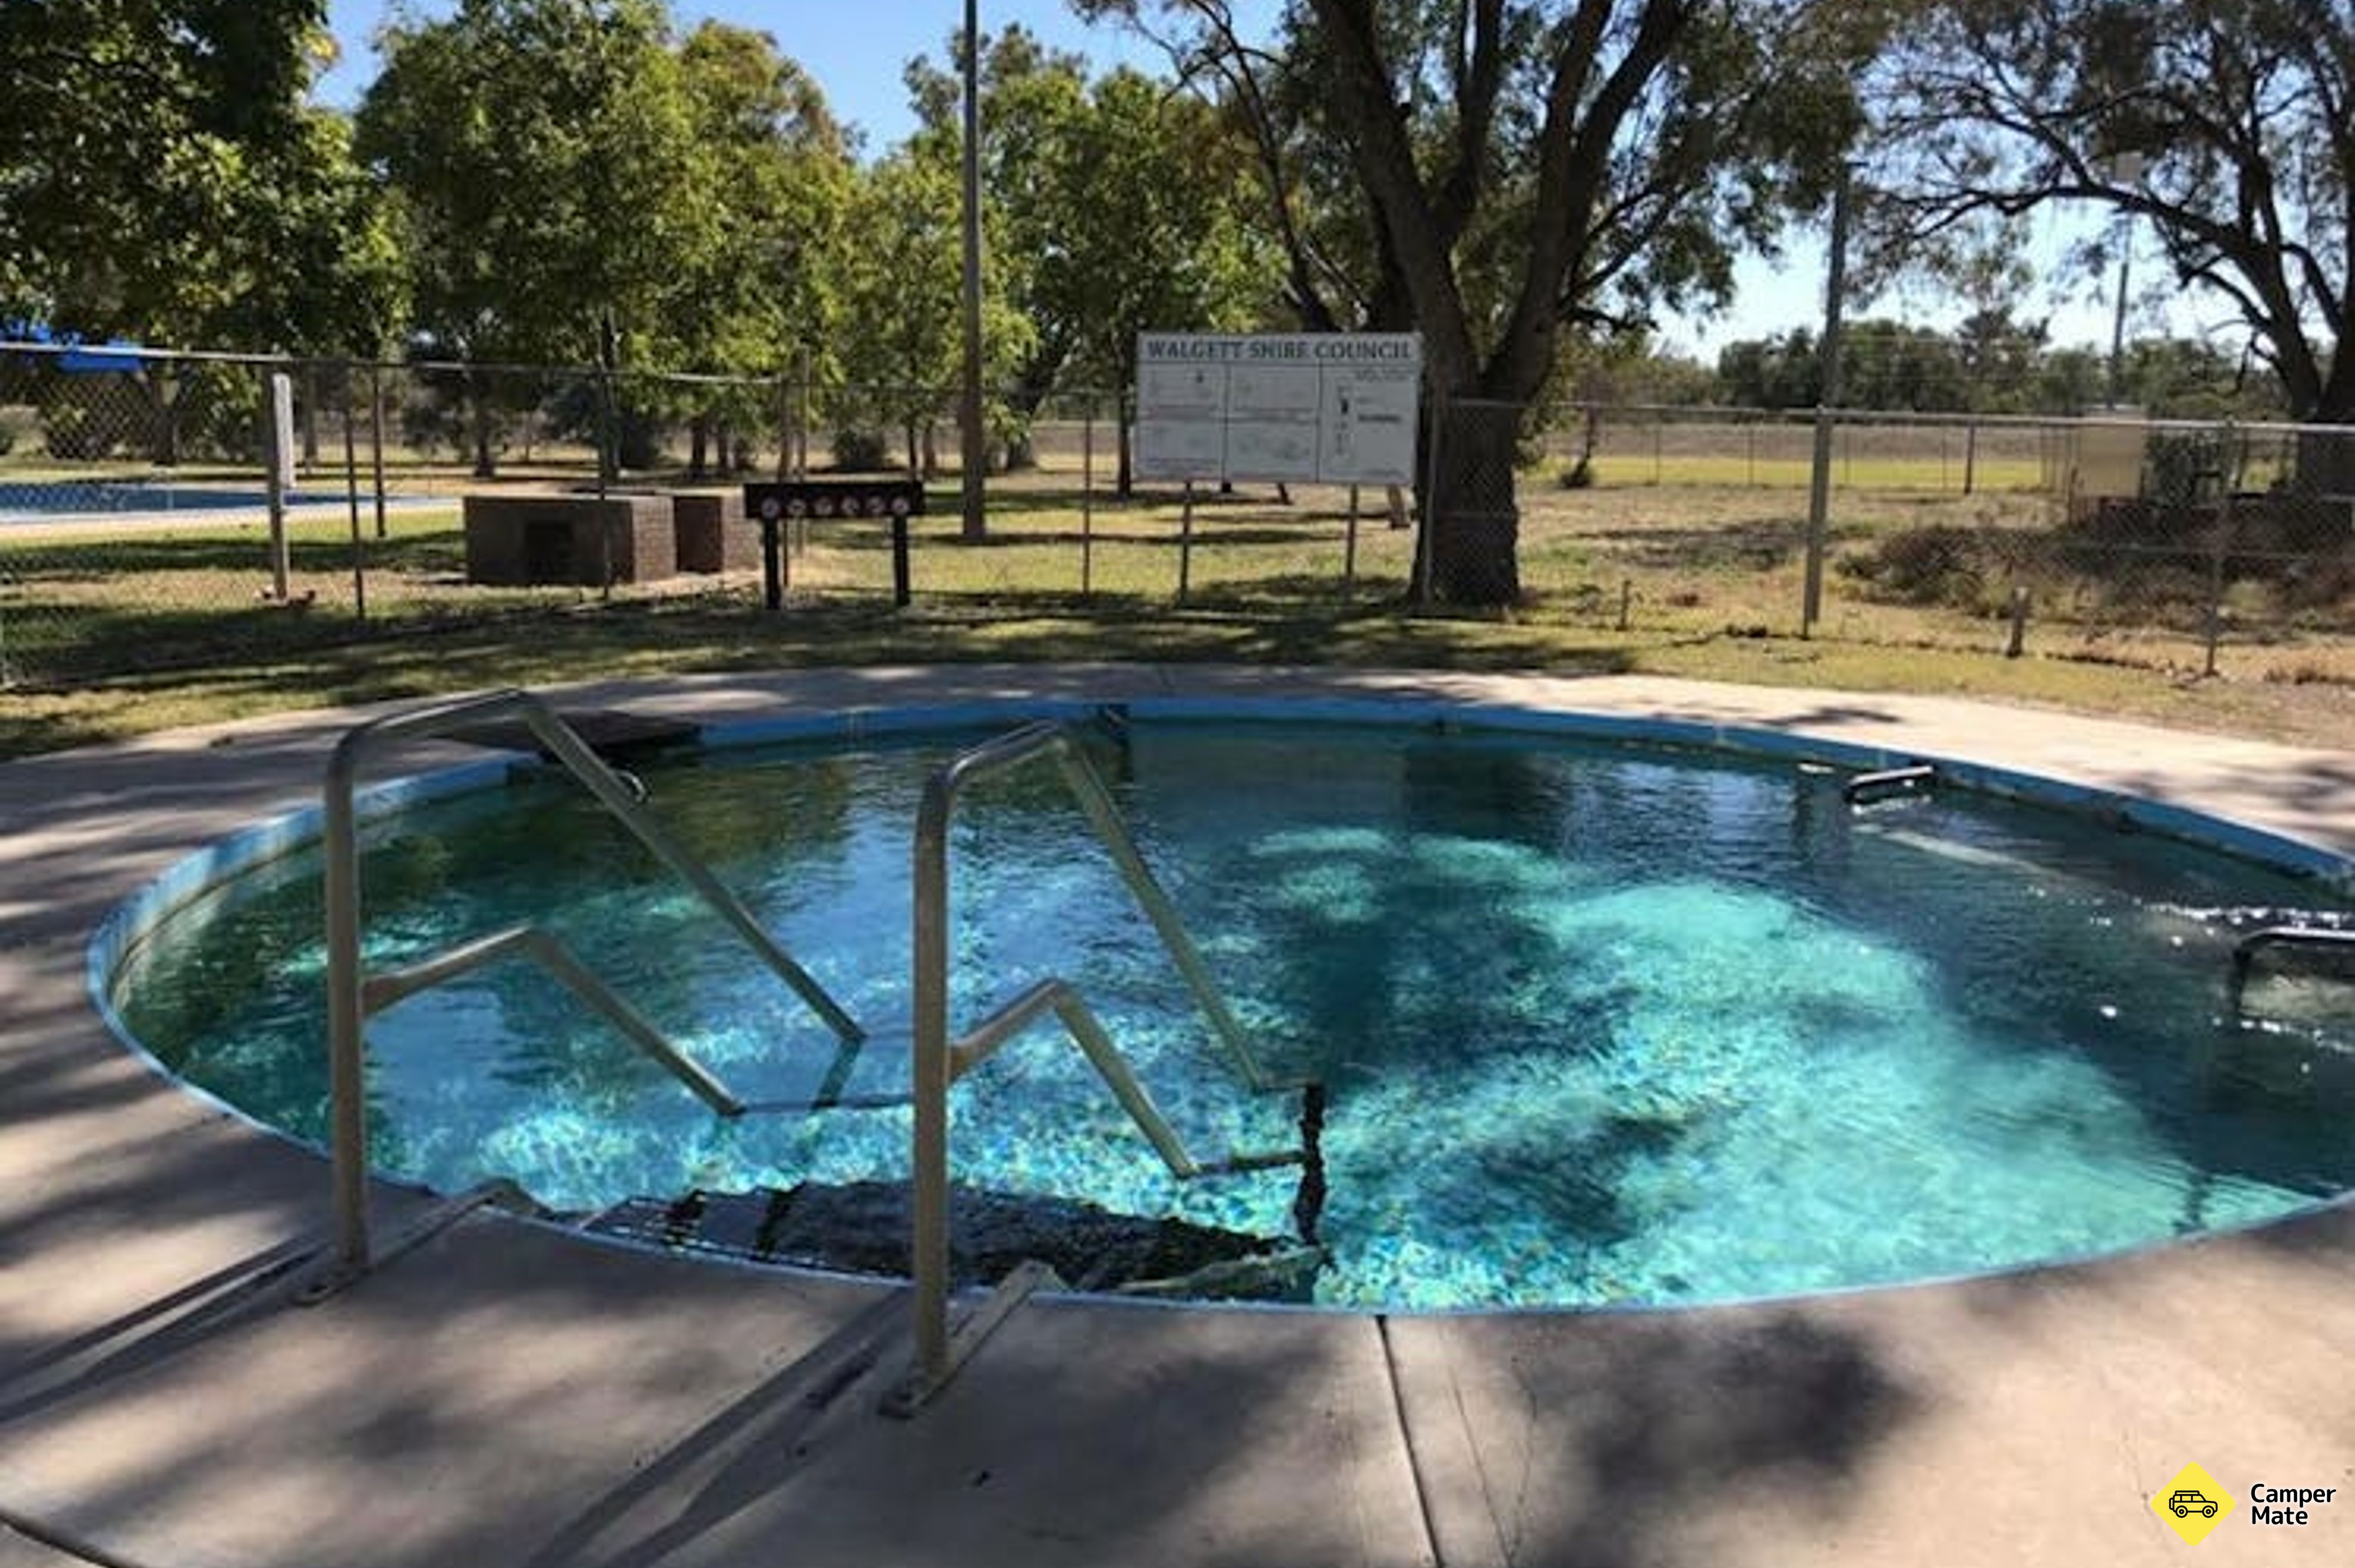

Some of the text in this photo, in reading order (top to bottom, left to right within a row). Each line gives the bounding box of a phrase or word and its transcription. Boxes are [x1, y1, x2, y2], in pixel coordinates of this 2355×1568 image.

[1147, 340, 1411, 360] WALGETT SHIRE COUNCIL
